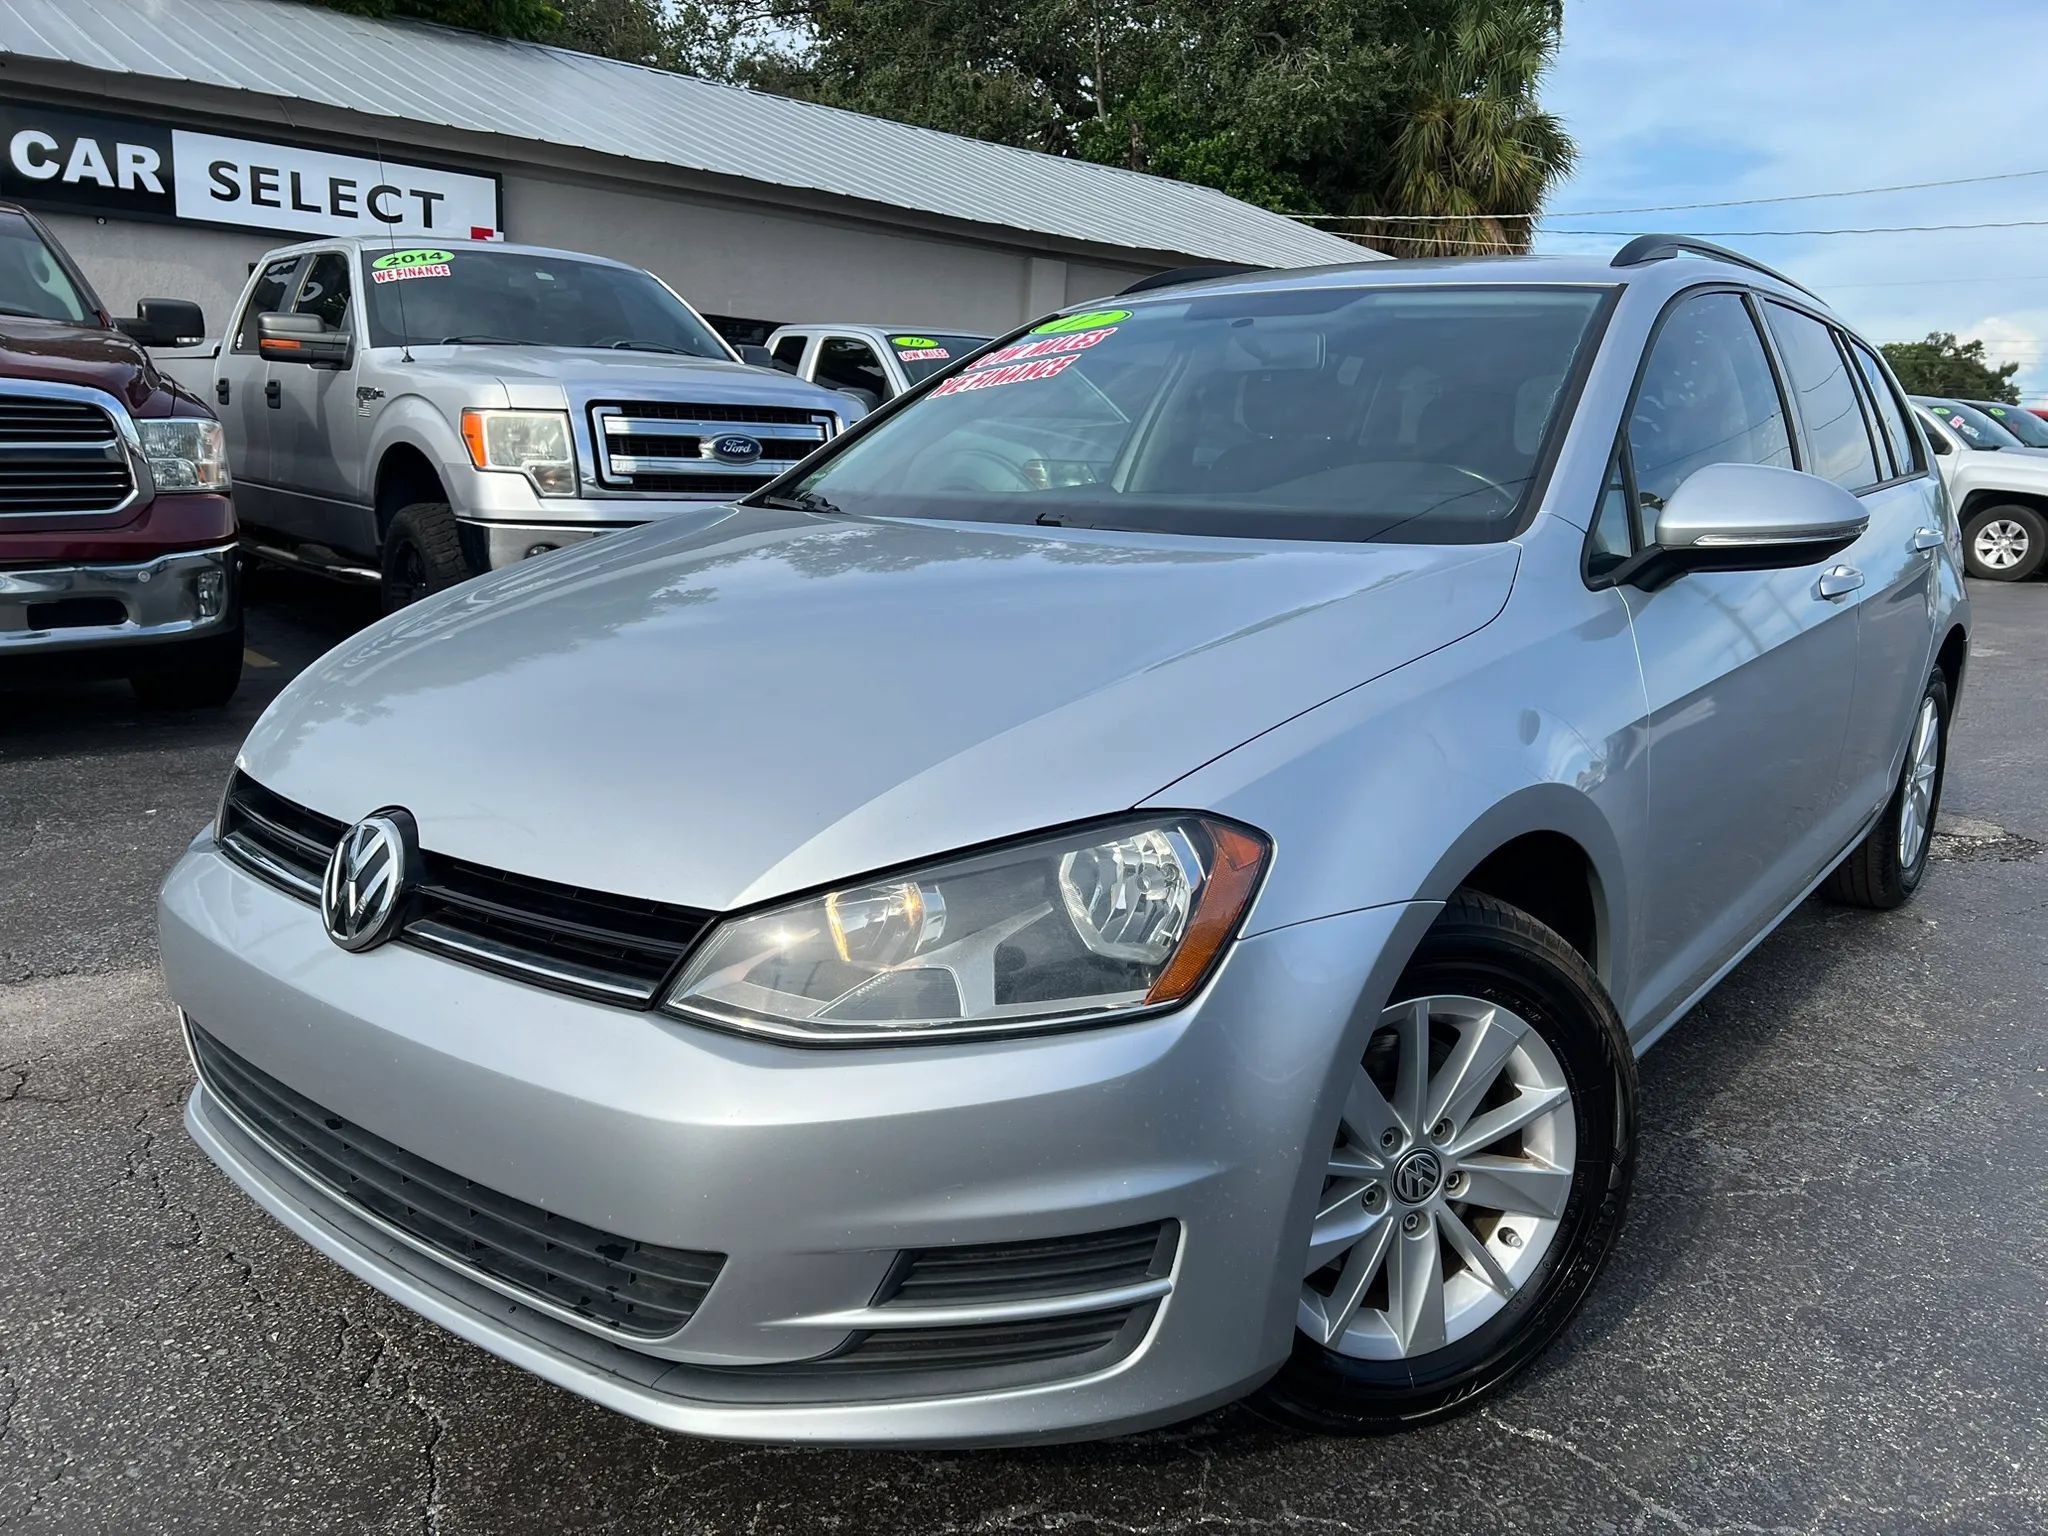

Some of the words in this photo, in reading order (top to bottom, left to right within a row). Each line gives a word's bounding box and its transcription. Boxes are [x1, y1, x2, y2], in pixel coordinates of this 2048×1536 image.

[10, 130, 165, 194] CAR
[208, 160, 444, 229] SELECT
[386, 251, 443, 267] 2014
[375, 269, 395, 282] WE
[396, 264, 449, 279] FINANCE
[900, 349, 920, 360] LOW
[922, 348, 948, 359] MILES
[966, 343, 1025, 371] LOW
[1023, 327, 1116, 359] MILES
[930, 373, 976, 398] WE
[962, 354, 1080, 391] FINANCE
[723, 439, 752, 453] Ford
